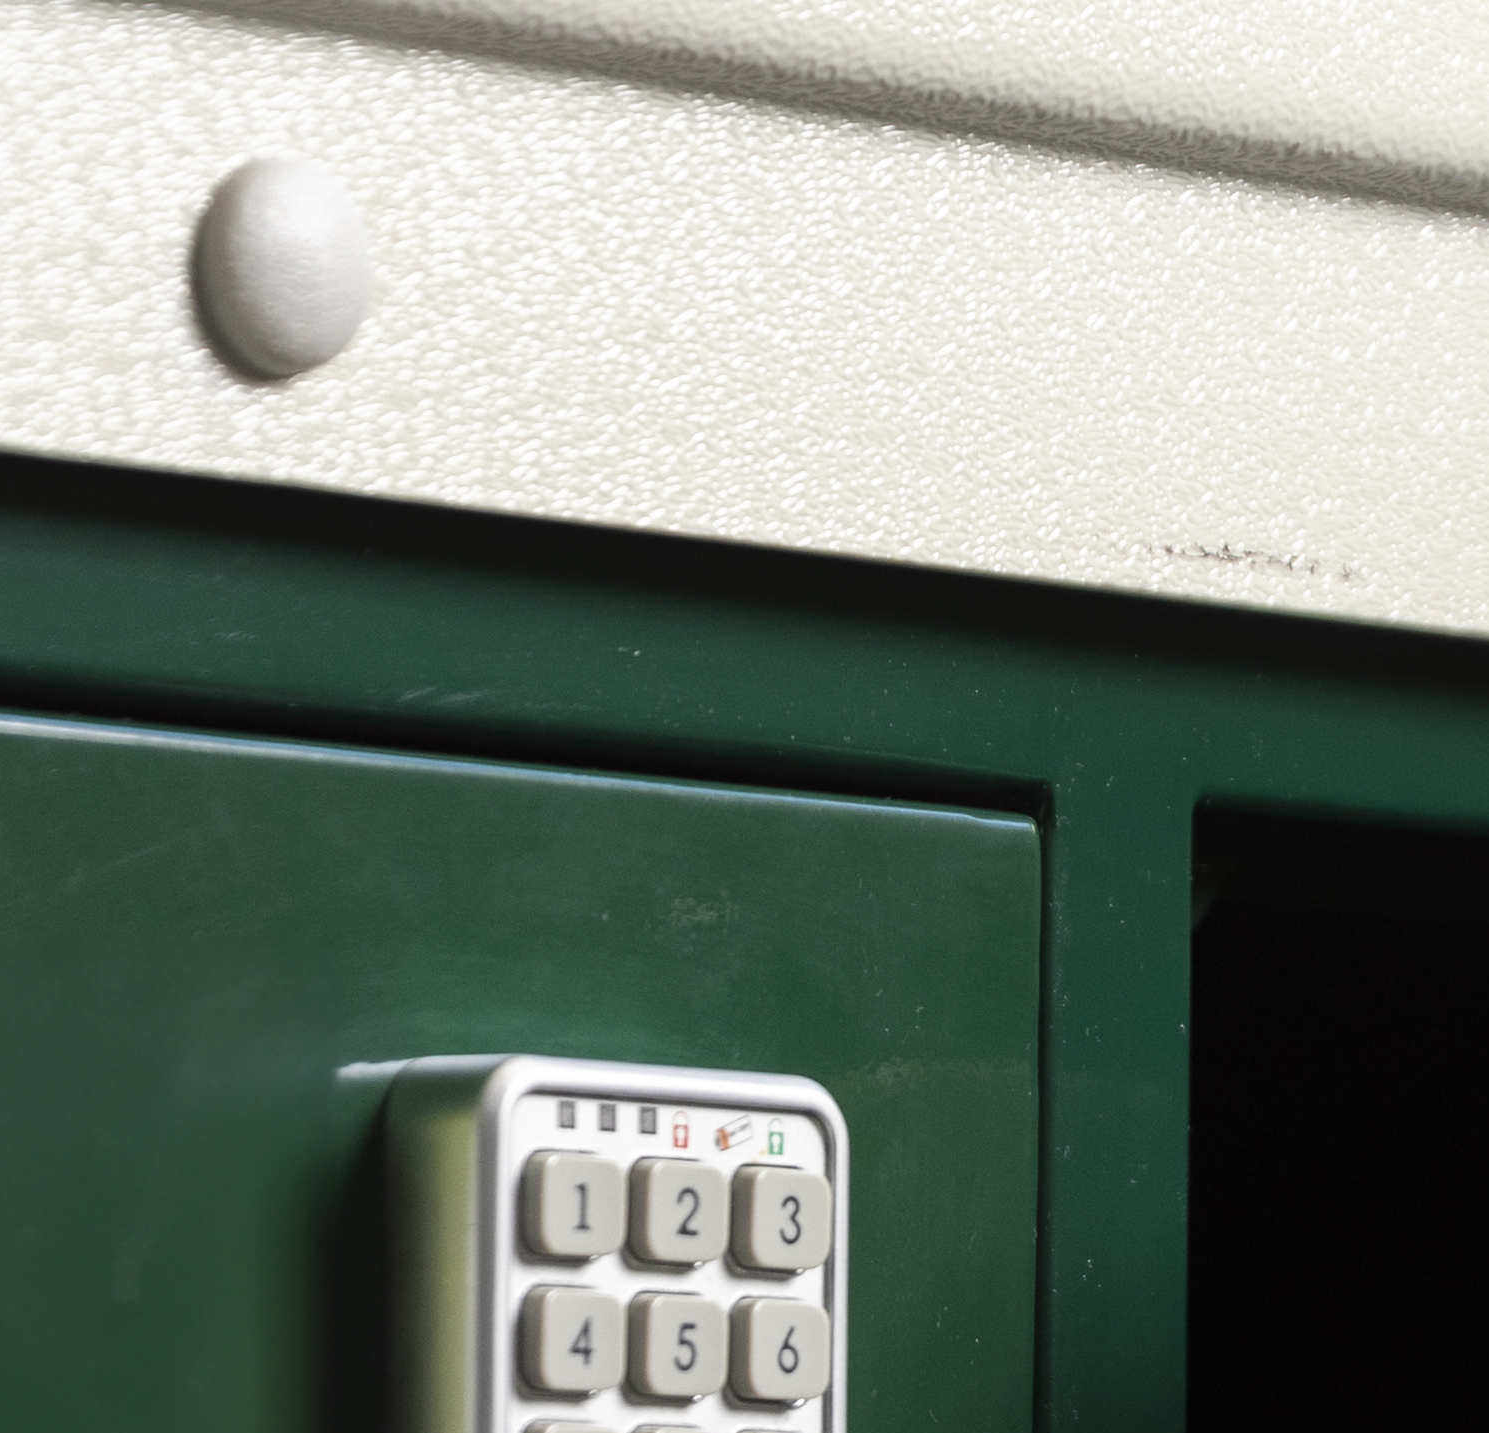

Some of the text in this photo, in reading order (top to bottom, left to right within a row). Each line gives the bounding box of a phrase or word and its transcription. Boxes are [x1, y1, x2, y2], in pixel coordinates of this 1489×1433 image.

[574, 1181, 804, 1247] 1 2 3
[568, 1314, 801, 1376] 4 5 6
